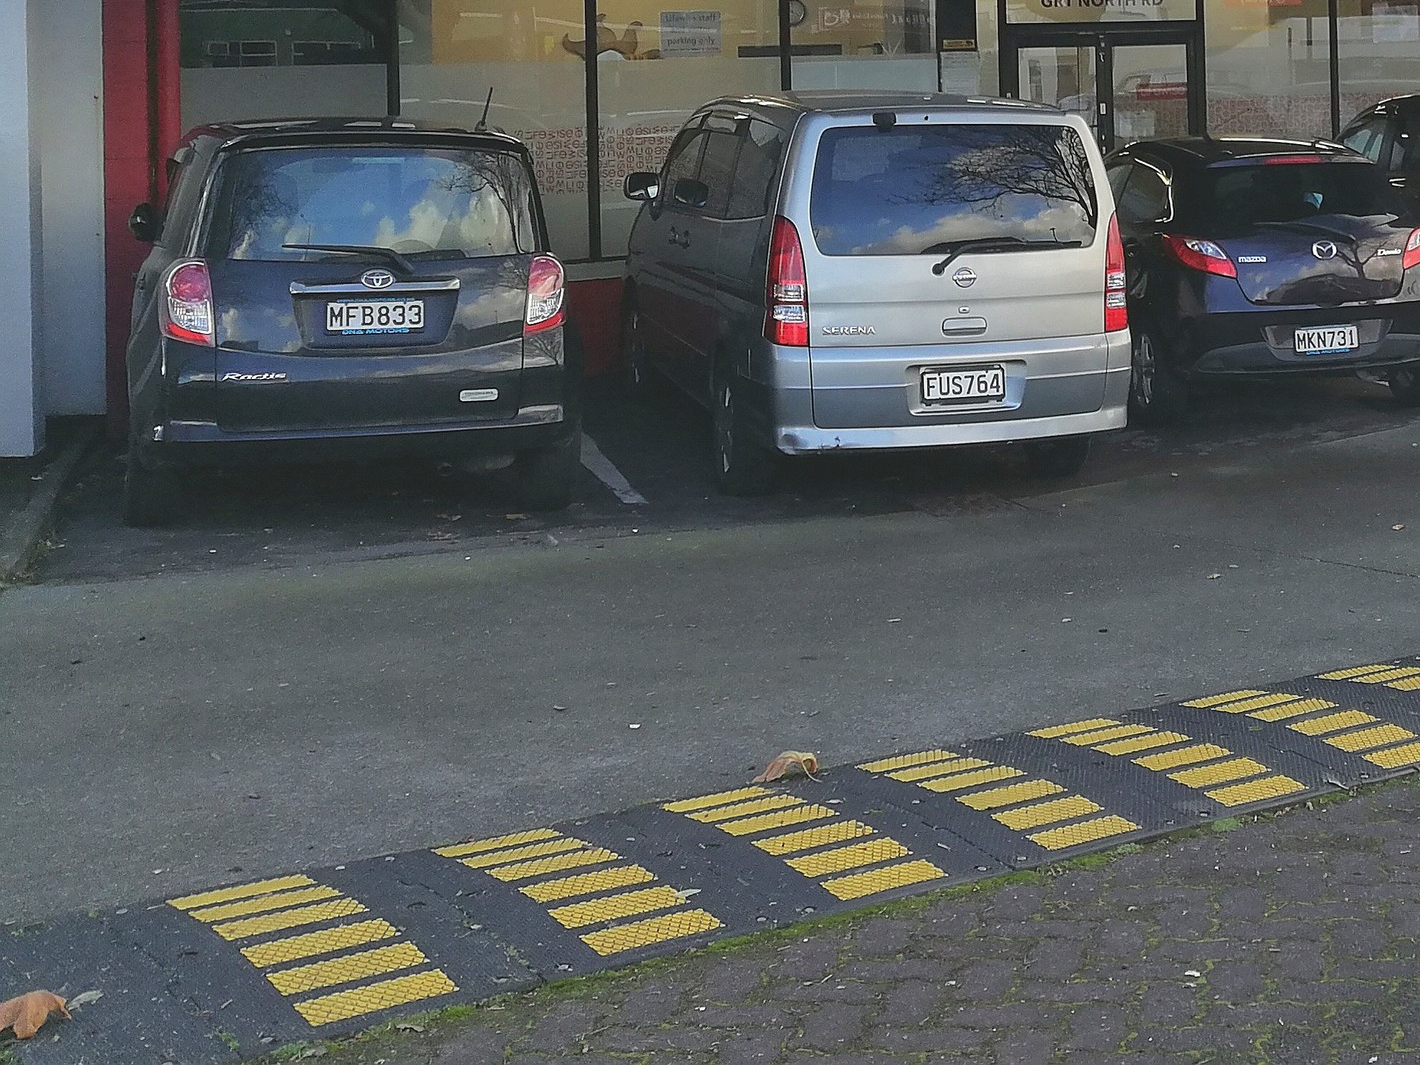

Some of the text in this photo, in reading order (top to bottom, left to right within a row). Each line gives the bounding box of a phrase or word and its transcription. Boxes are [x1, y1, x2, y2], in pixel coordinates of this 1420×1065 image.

[667, 35, 716, 46] parking only
[330, 305, 421, 327] MFB833
[822, 326, 876, 335] SERENA
[1297, 330, 1354, 349] MKN731
[927, 374, 1000, 397] FUS764
